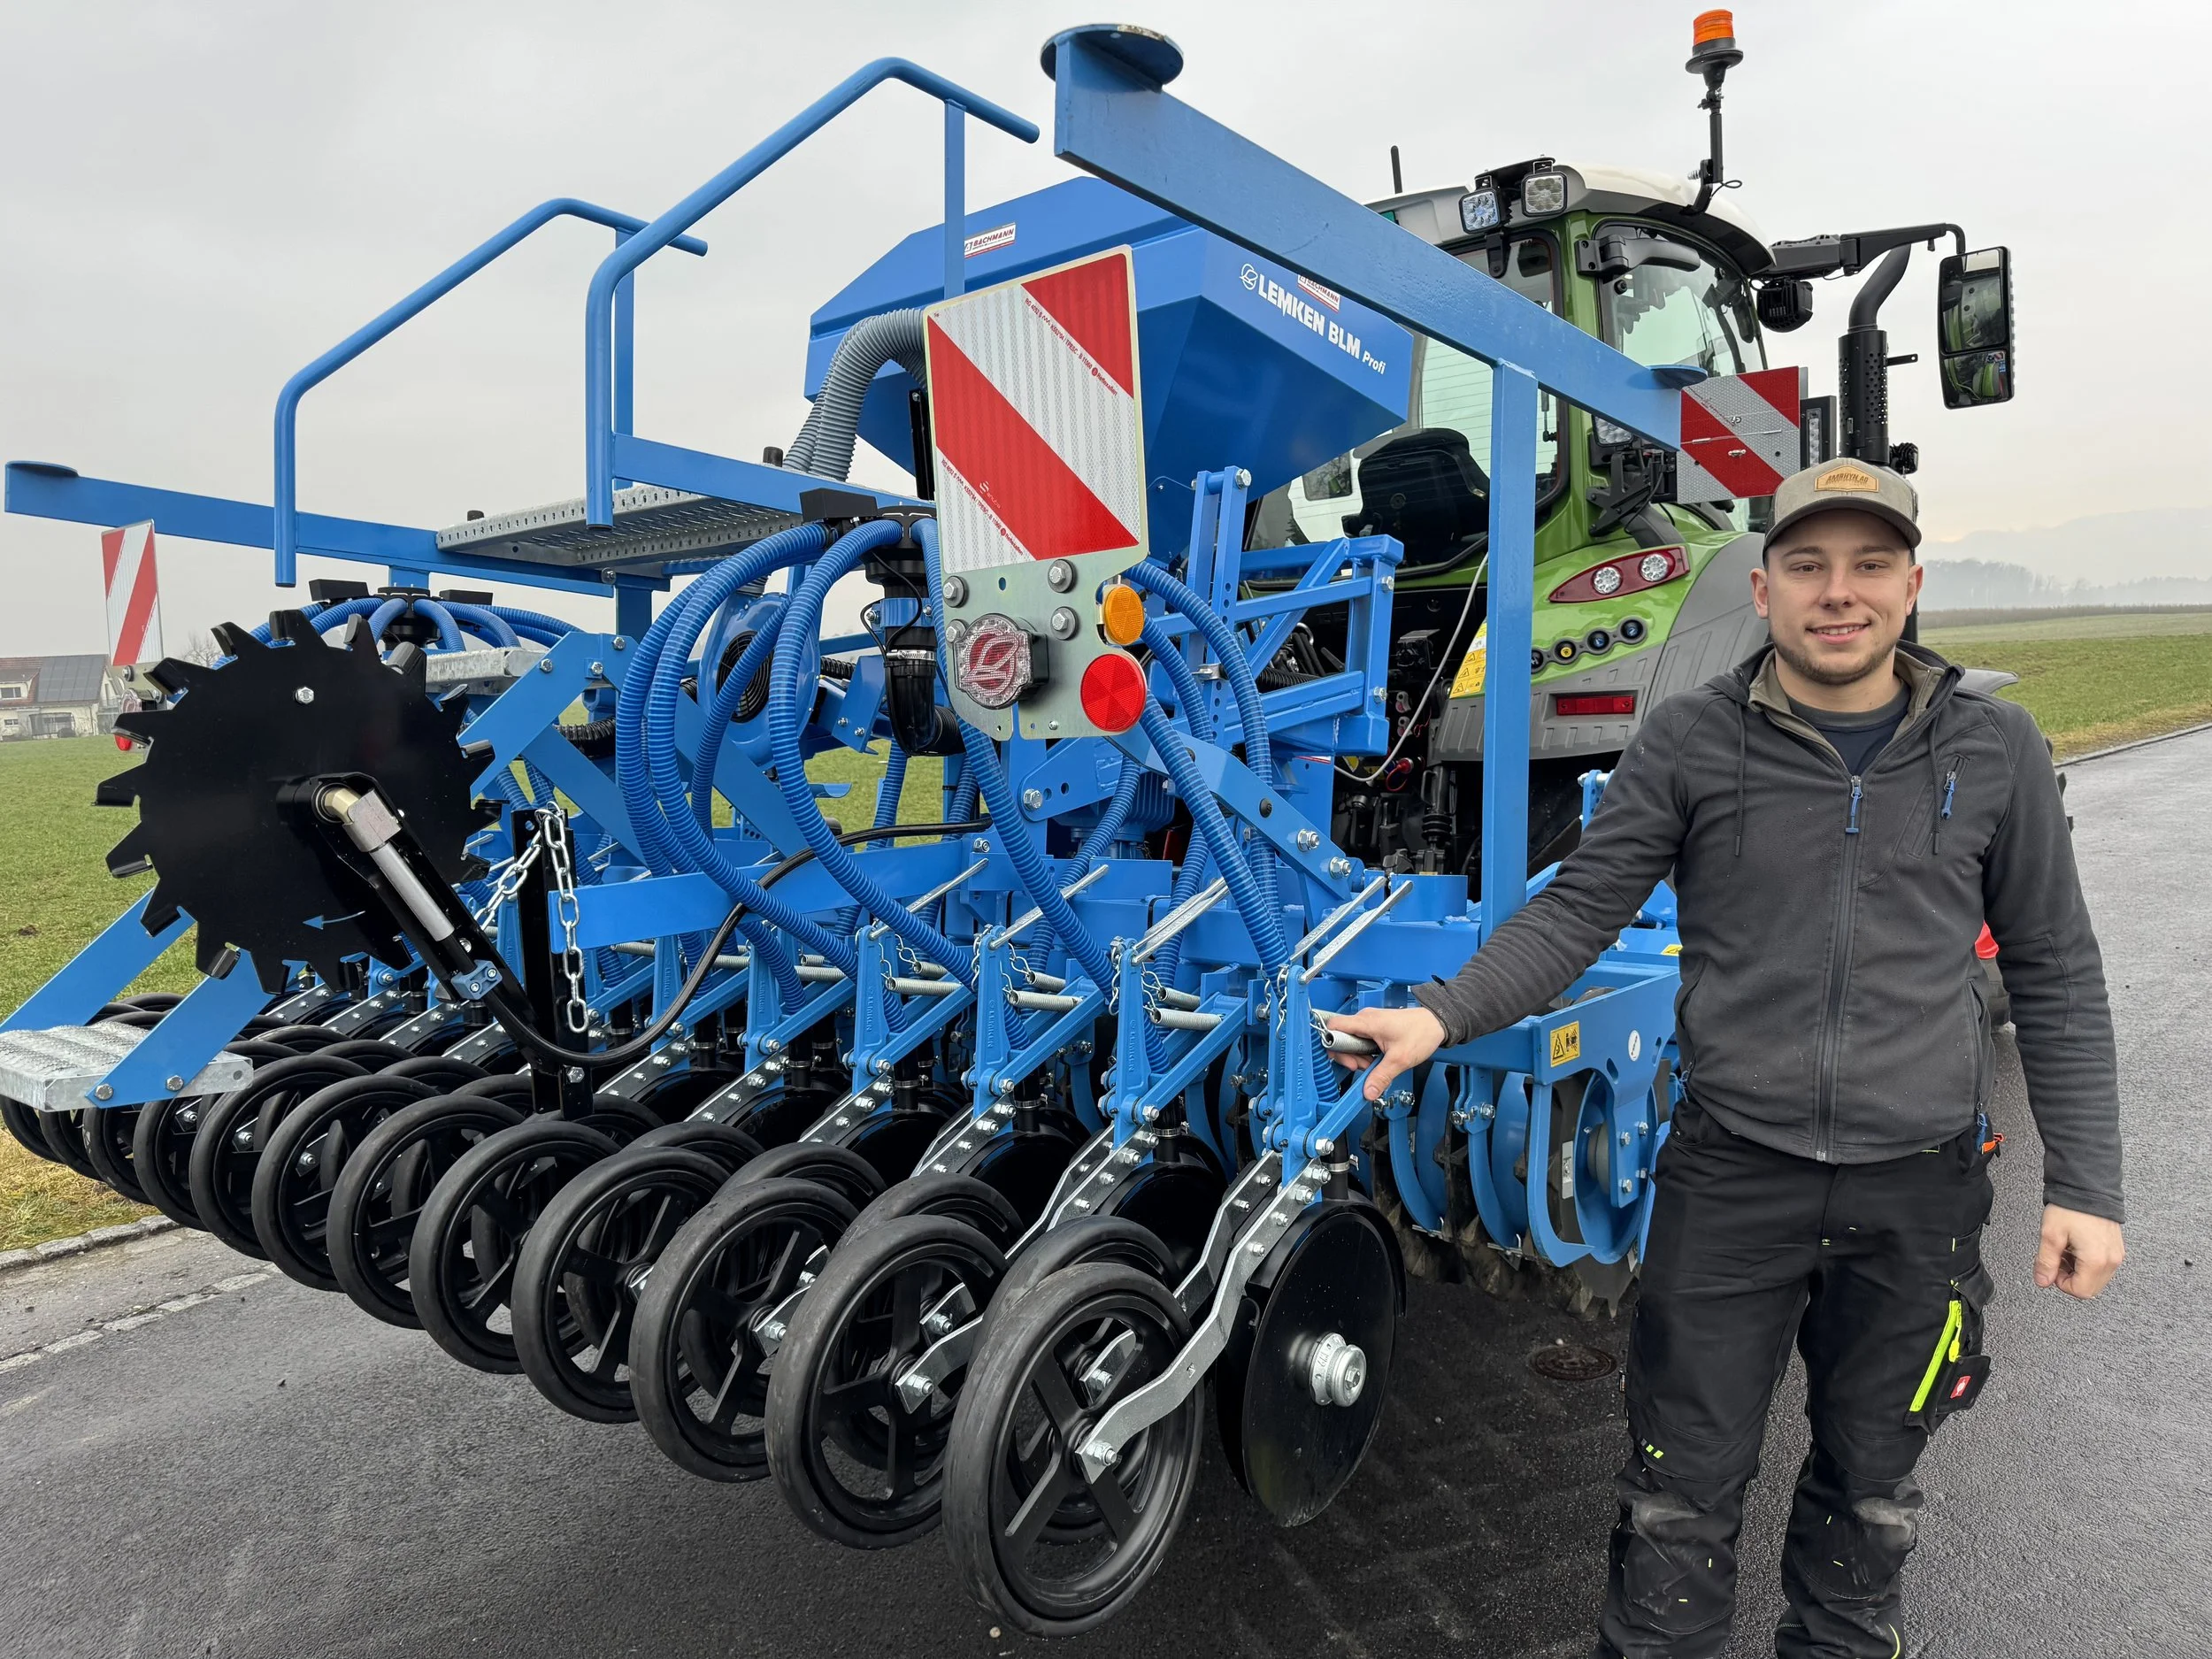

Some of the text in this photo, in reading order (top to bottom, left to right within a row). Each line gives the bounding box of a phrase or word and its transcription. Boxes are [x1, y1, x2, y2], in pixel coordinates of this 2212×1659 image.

[973, 228, 1014, 247] BACHMANN
[1257, 273, 1325, 336] LEMKEN
[1327, 320, 1361, 359] BLM
[1362, 350, 1386, 375] Profi
